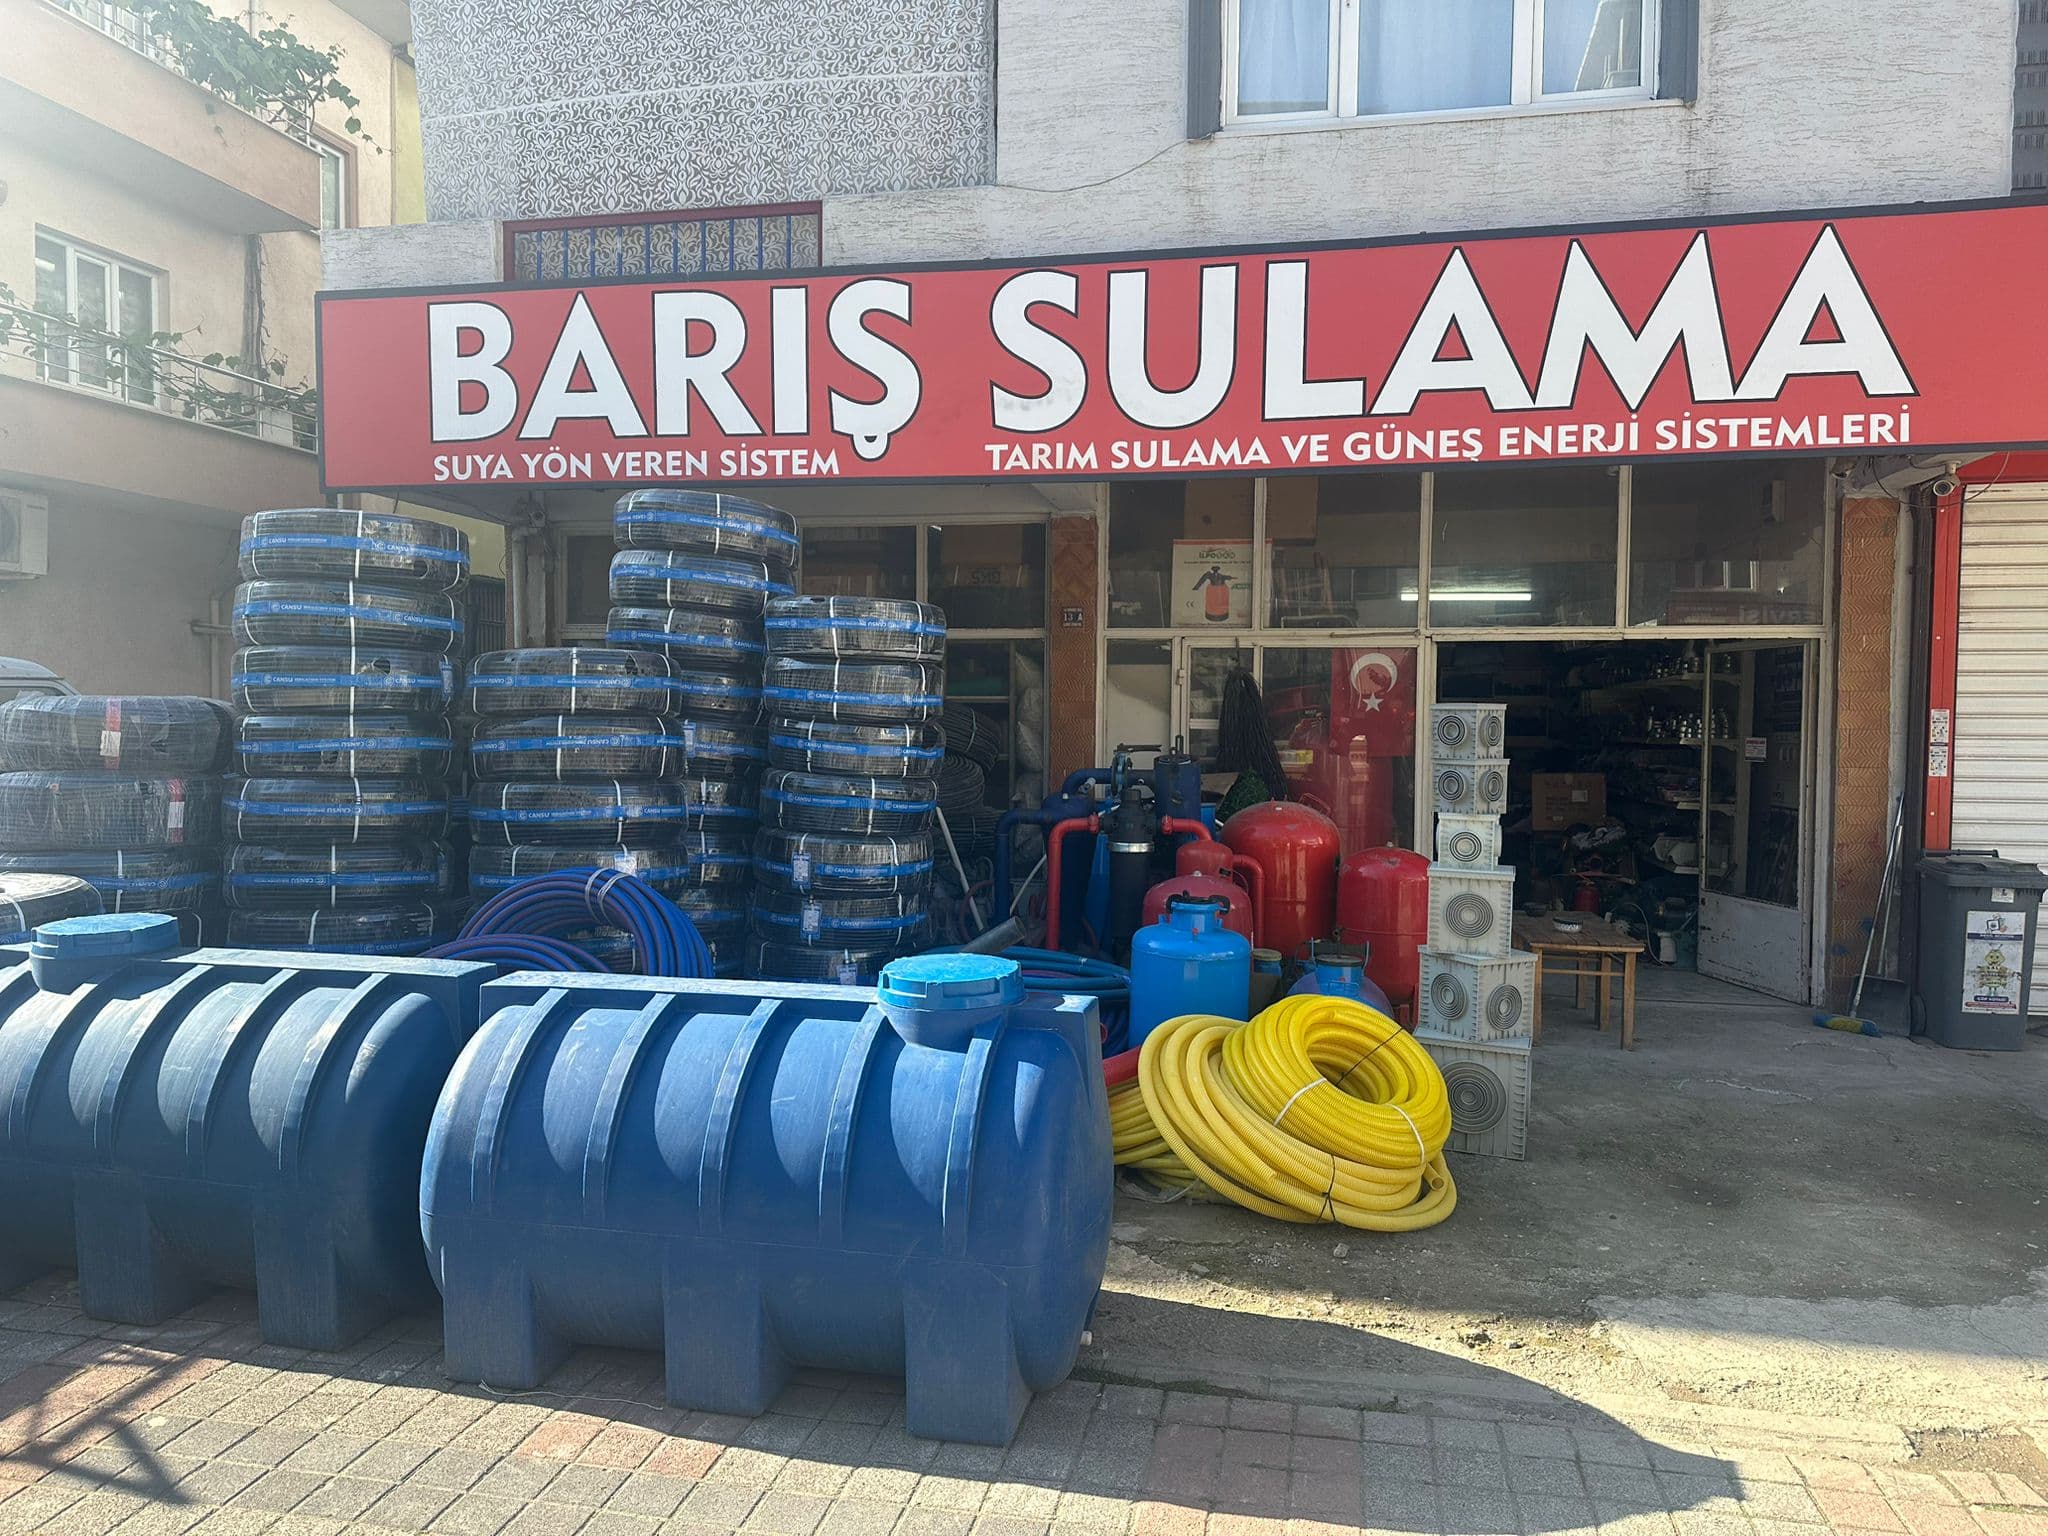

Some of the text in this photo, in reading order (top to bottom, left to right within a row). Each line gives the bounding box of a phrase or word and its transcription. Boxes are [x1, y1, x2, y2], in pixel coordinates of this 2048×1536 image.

[429, 225, 1917, 460] BARIŞ SULAMA
[433, 443, 840, 482] SUYA YÖN VEREN SİSTEM
[984, 404, 1911, 471] TARIM SULAMA VE GÜNEŞ ENERJİ SİSTEMLERİ
